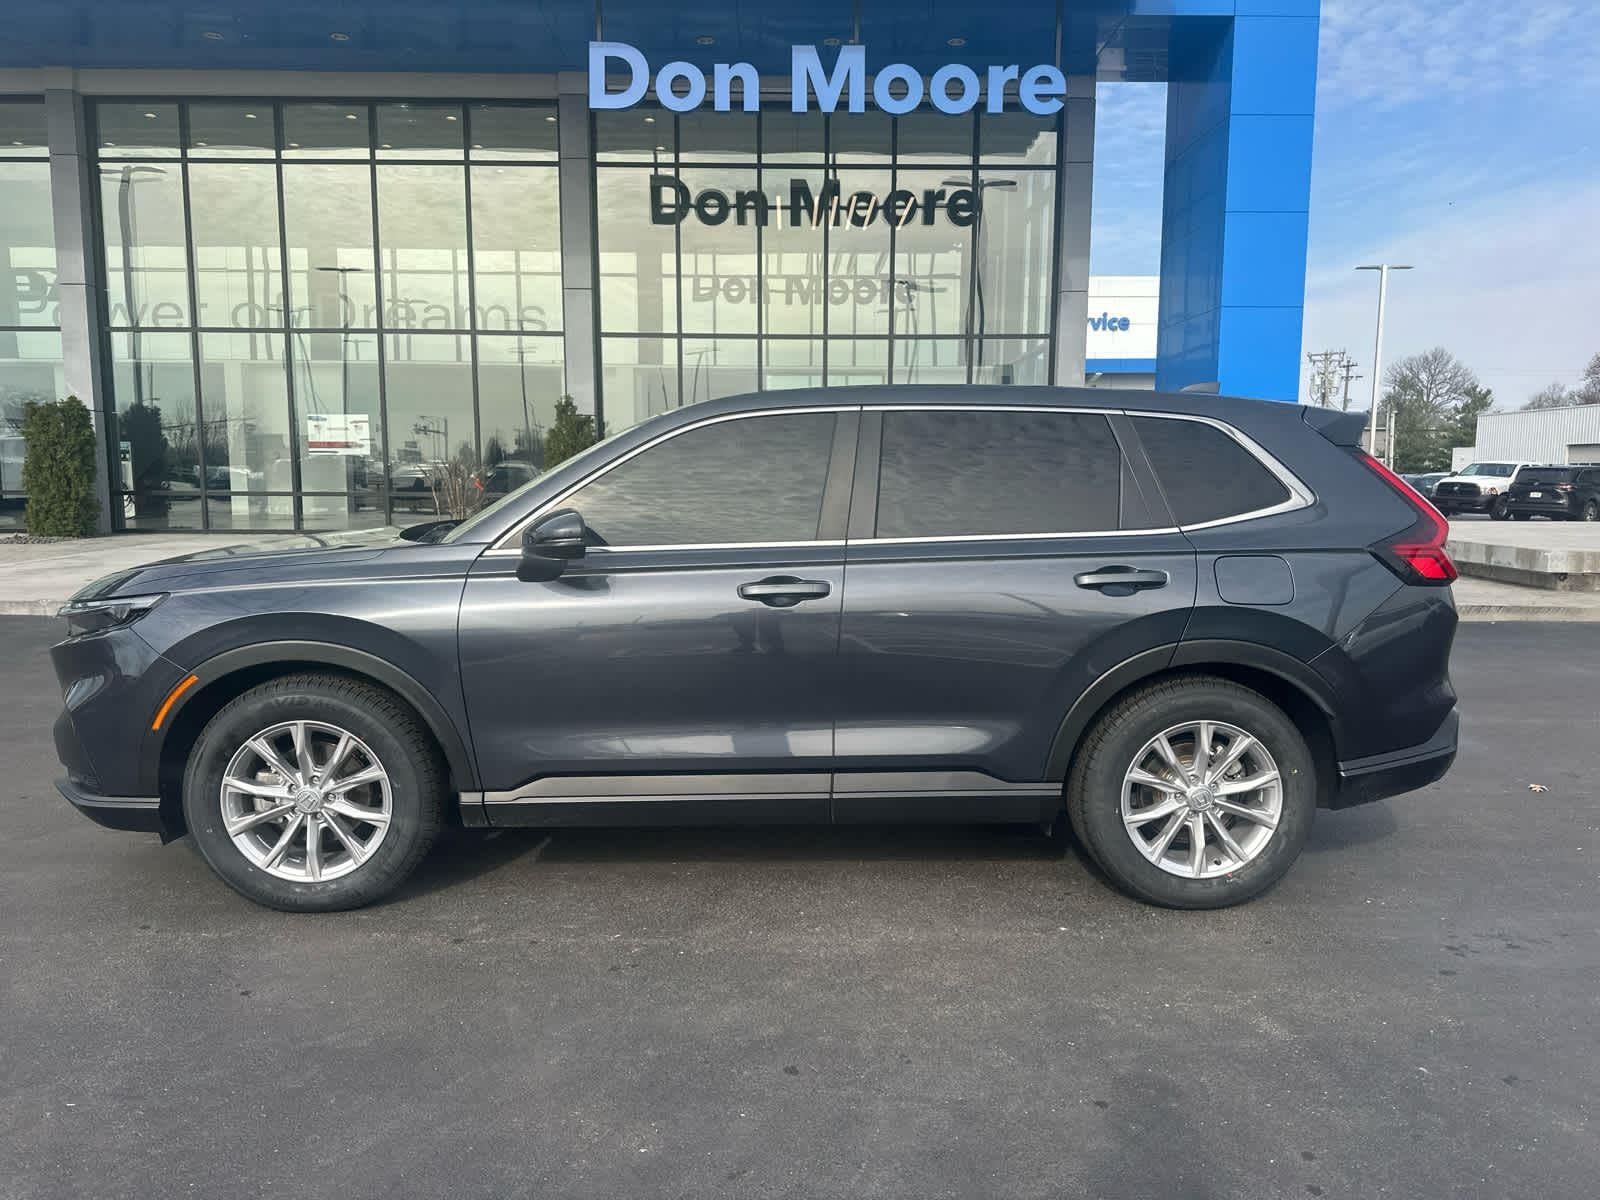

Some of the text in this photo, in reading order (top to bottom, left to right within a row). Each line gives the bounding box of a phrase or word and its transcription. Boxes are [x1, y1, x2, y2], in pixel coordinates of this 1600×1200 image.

[588, 41, 1067, 115] Don Moore
[650, 174, 978, 227] Don Moore
[16, 284, 208, 330] Pwer
[1087, 311, 1130, 332] vice
